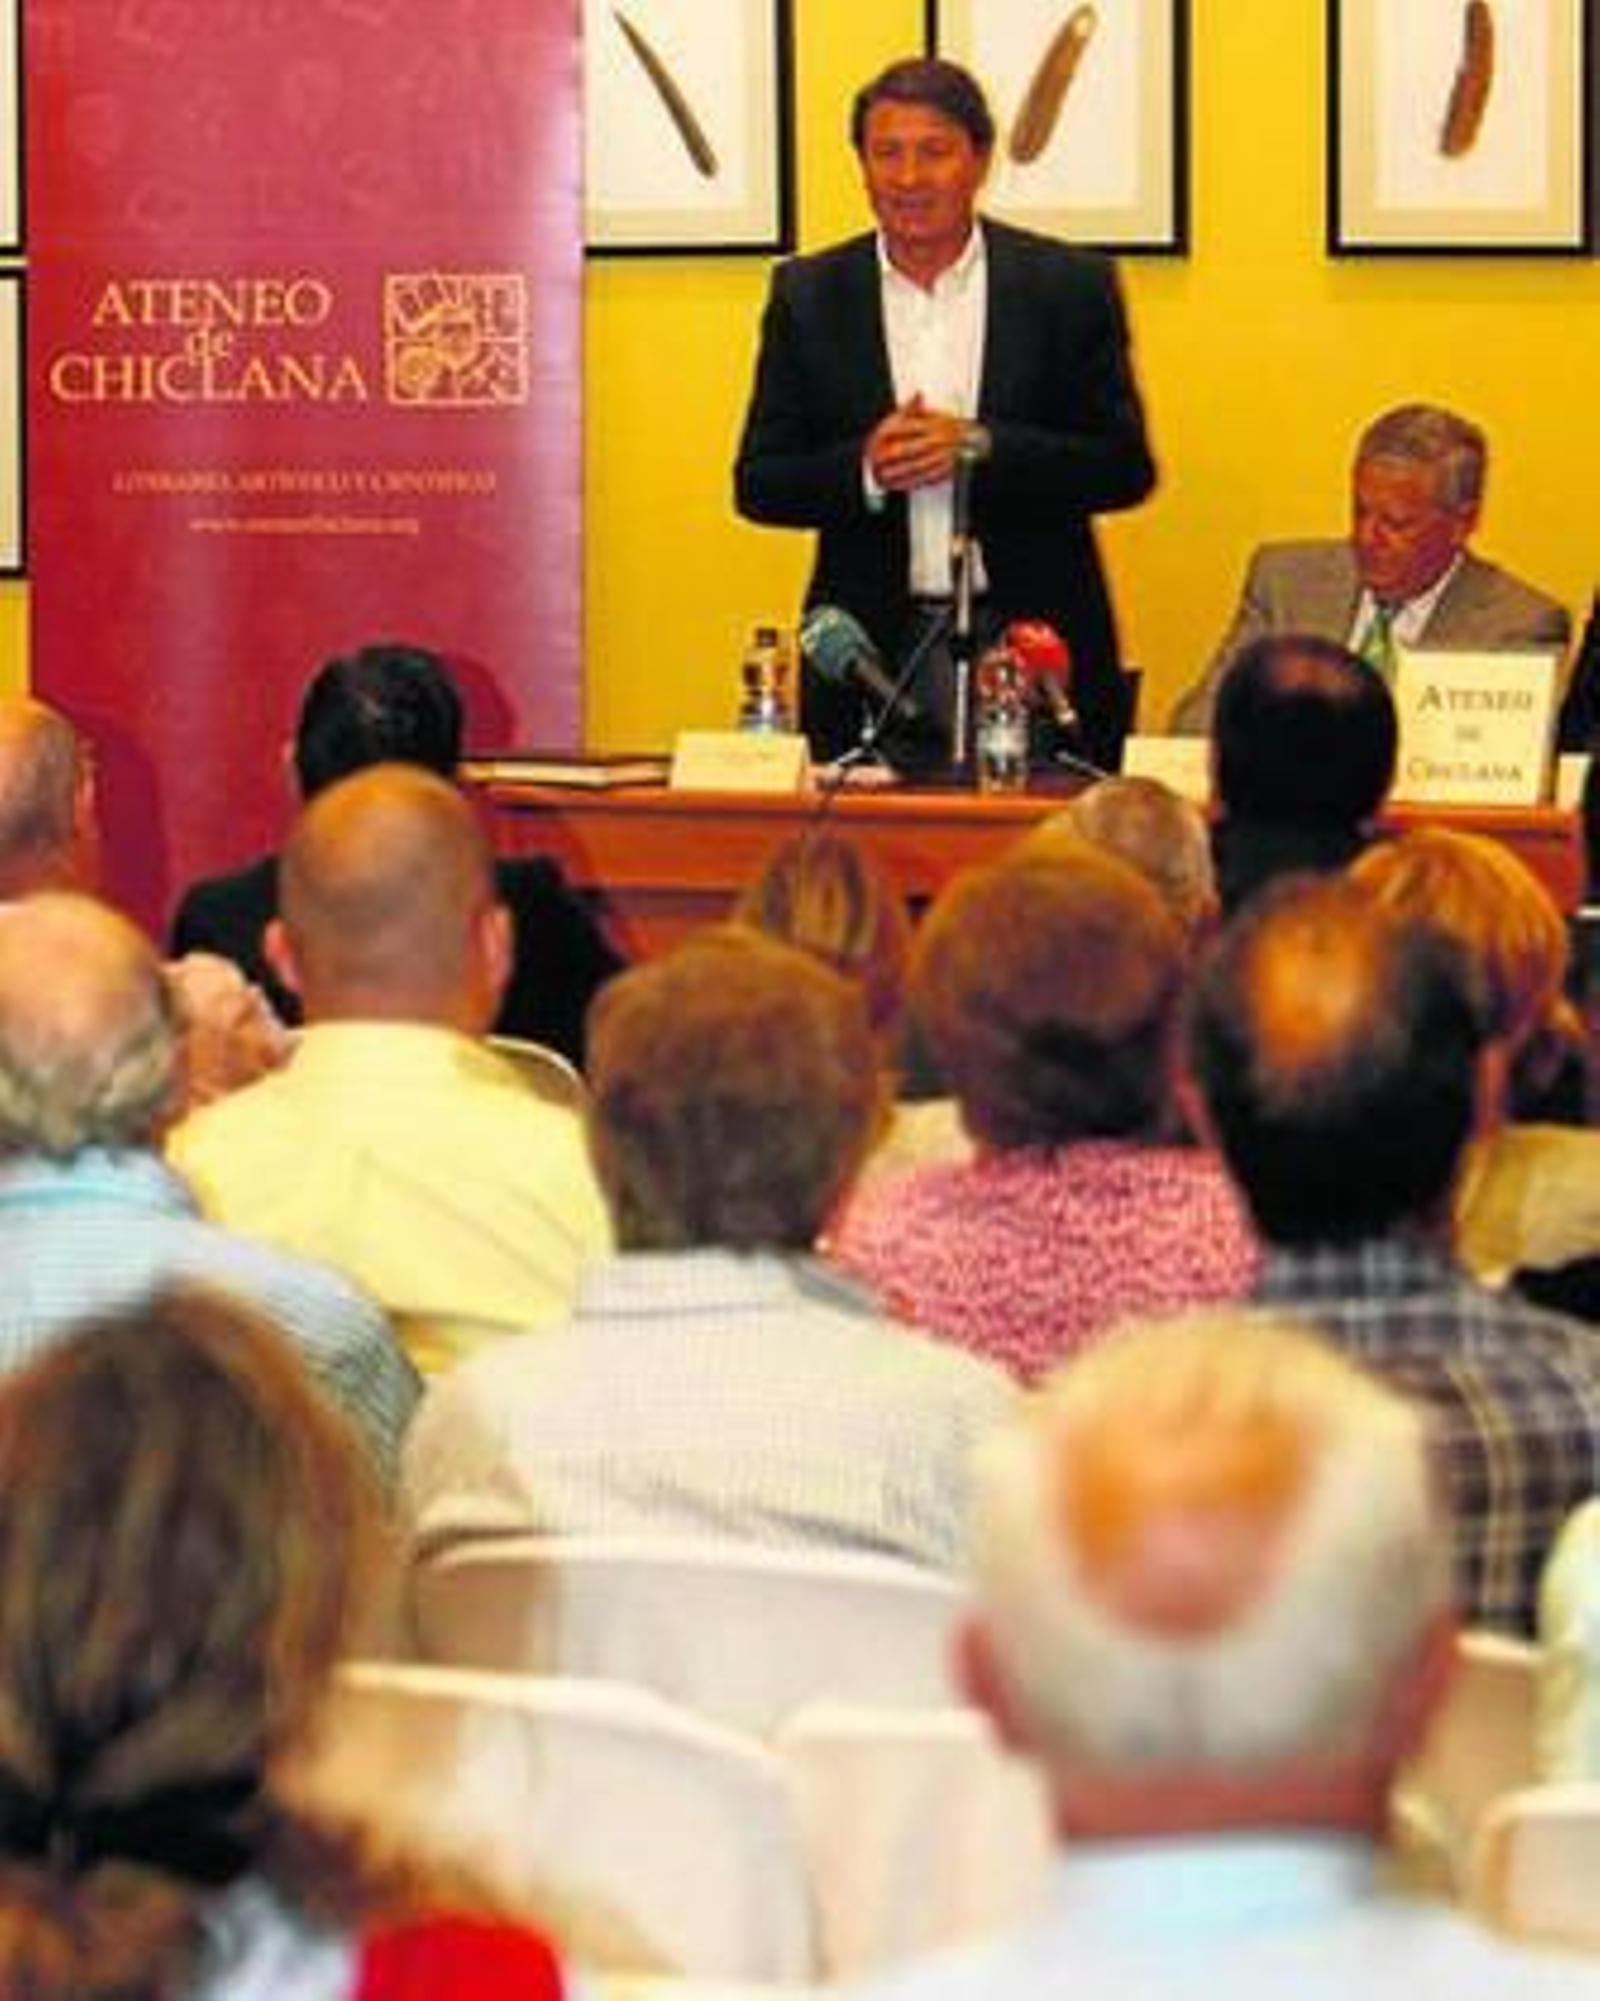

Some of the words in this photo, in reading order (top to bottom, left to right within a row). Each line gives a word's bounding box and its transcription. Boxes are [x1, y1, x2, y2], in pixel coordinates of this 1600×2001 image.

[92, 279, 332, 325] ATENEO
[183, 321, 234, 360] de
[50, 353, 369, 402] CHICLANA
